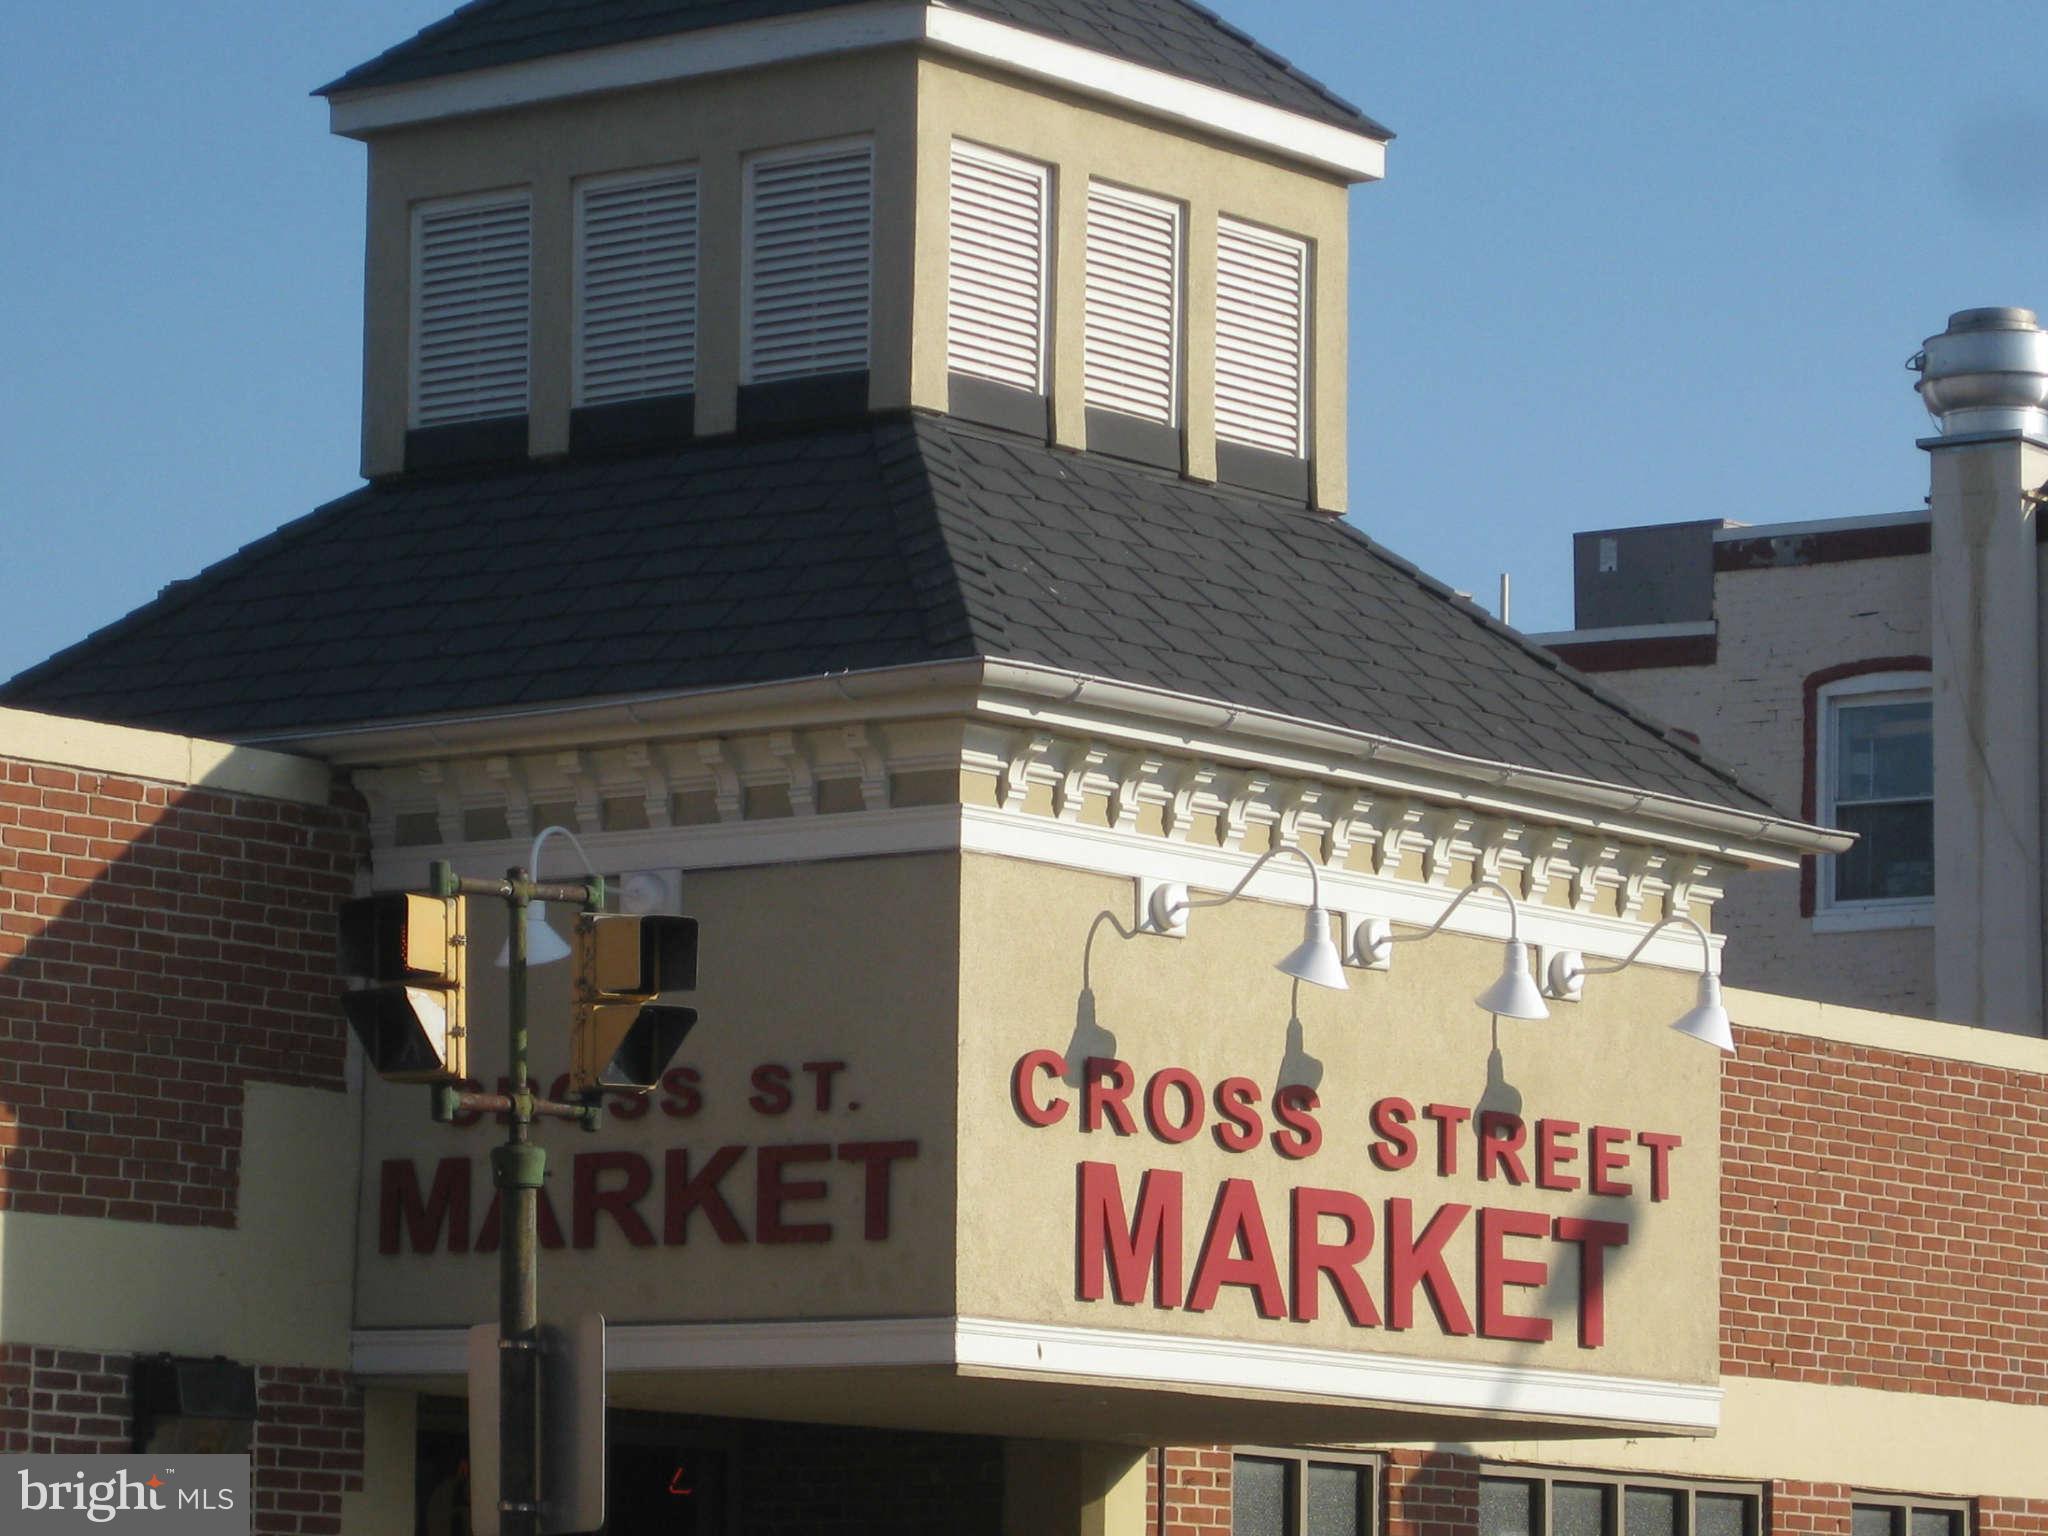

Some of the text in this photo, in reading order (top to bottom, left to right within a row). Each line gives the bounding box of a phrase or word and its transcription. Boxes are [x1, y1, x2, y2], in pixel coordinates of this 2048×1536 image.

[748, 1060, 861, 1115] ST.
[1012, 1049, 1684, 1201] CROSS STREET
[1075, 1160, 1630, 1349] MARKET
